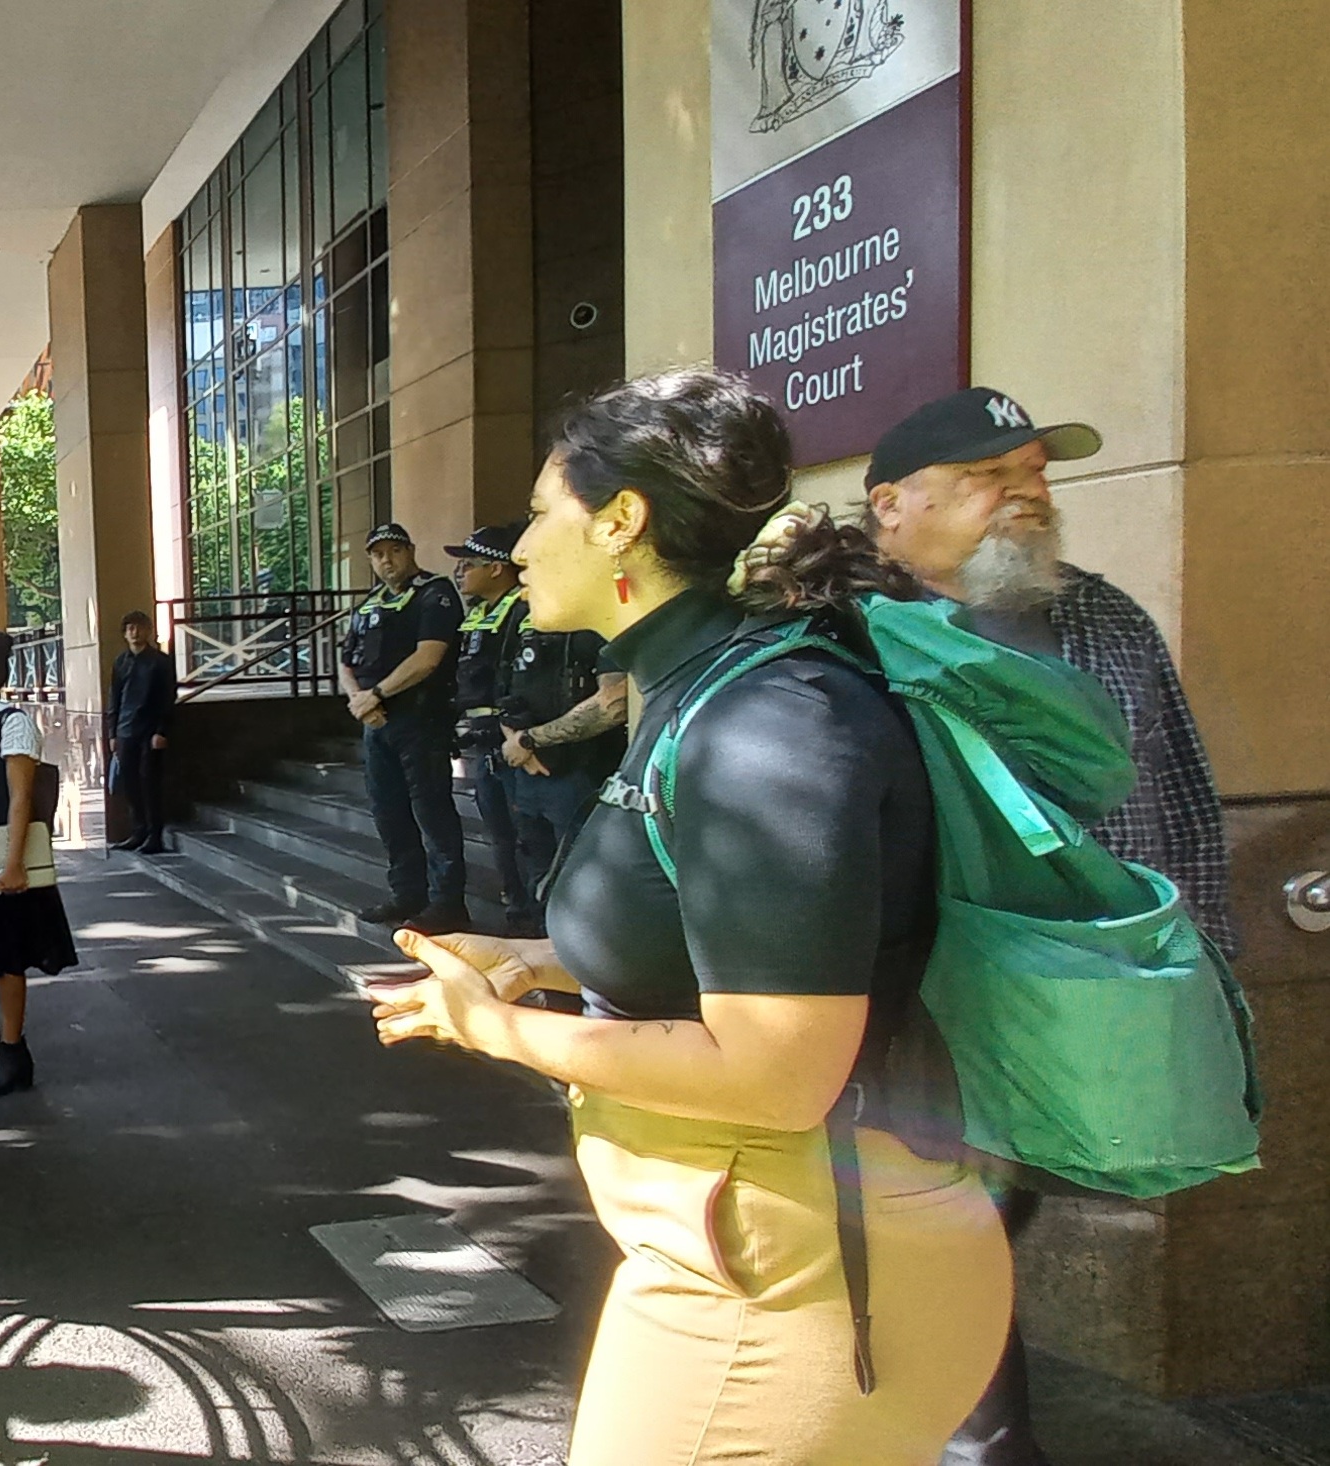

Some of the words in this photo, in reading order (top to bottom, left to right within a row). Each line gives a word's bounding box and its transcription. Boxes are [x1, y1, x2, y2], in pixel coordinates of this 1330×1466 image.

[792, 174, 854, 241] 233
[754, 227, 901, 314] Melbourne
[749, 267, 915, 370] Magistrates'
[786, 354, 864, 411] Court
